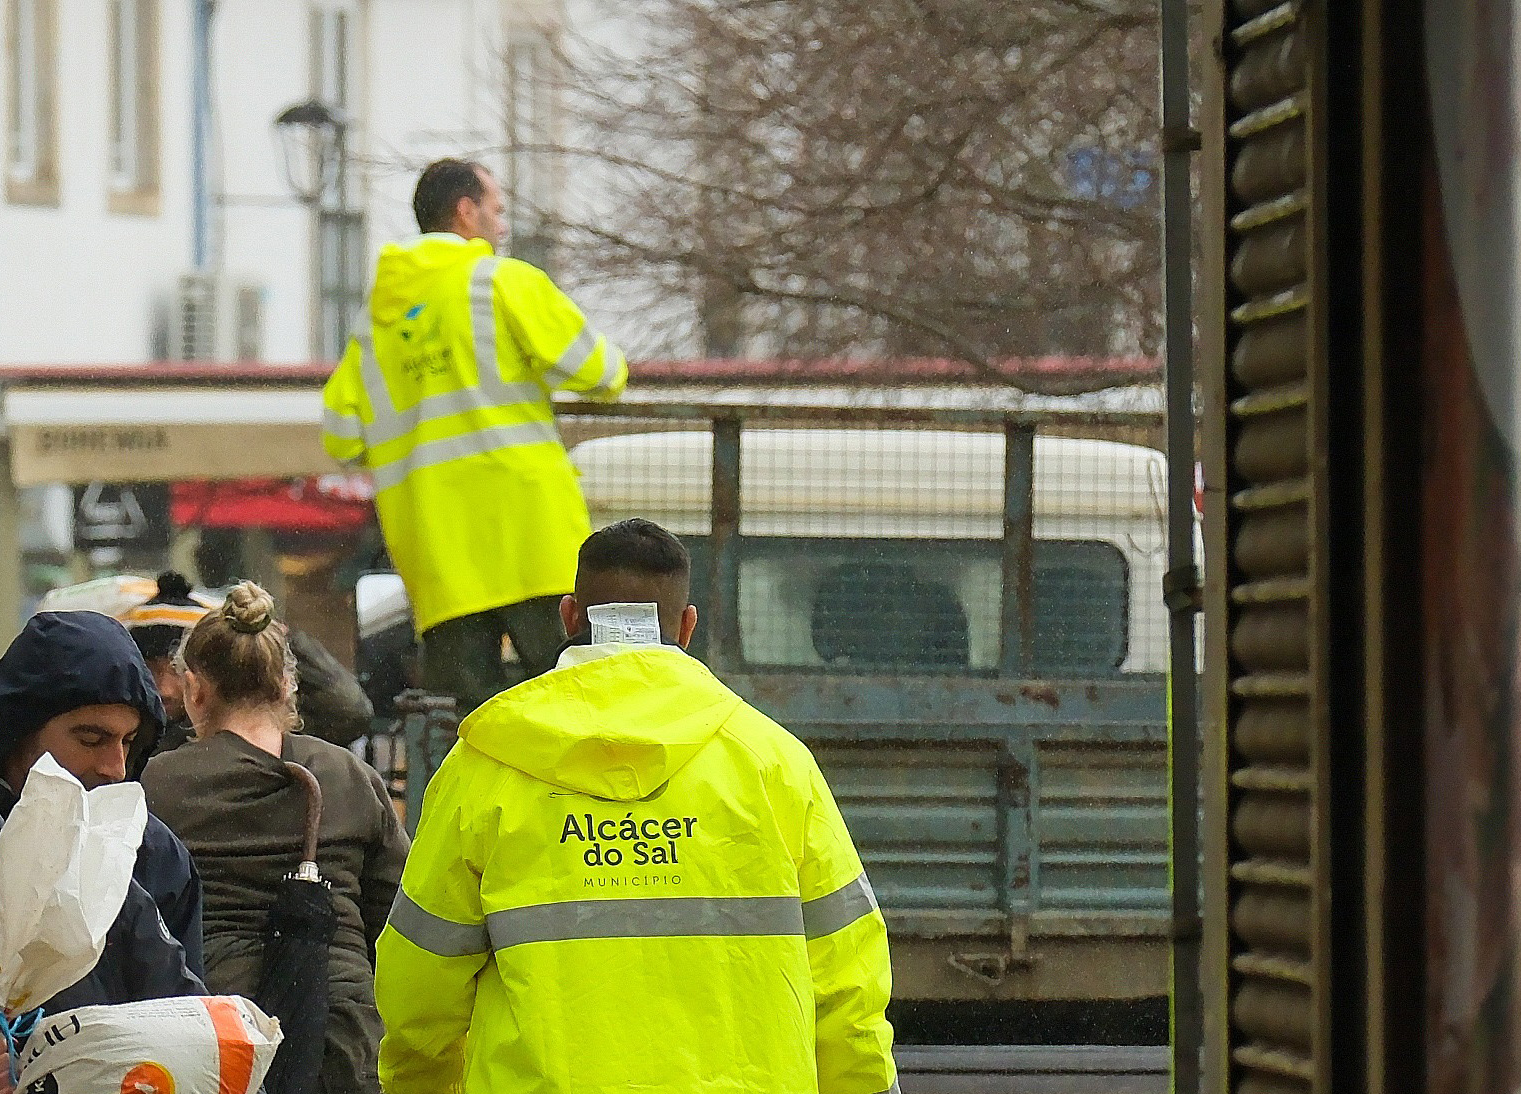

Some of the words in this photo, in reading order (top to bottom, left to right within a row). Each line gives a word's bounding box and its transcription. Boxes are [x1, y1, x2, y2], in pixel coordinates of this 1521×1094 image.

[559, 812, 698, 844] Alcácer
[583, 842, 624, 867] do
[632, 840, 679, 866] Sal
[583, 875, 682, 888] MUNICÍPIO
